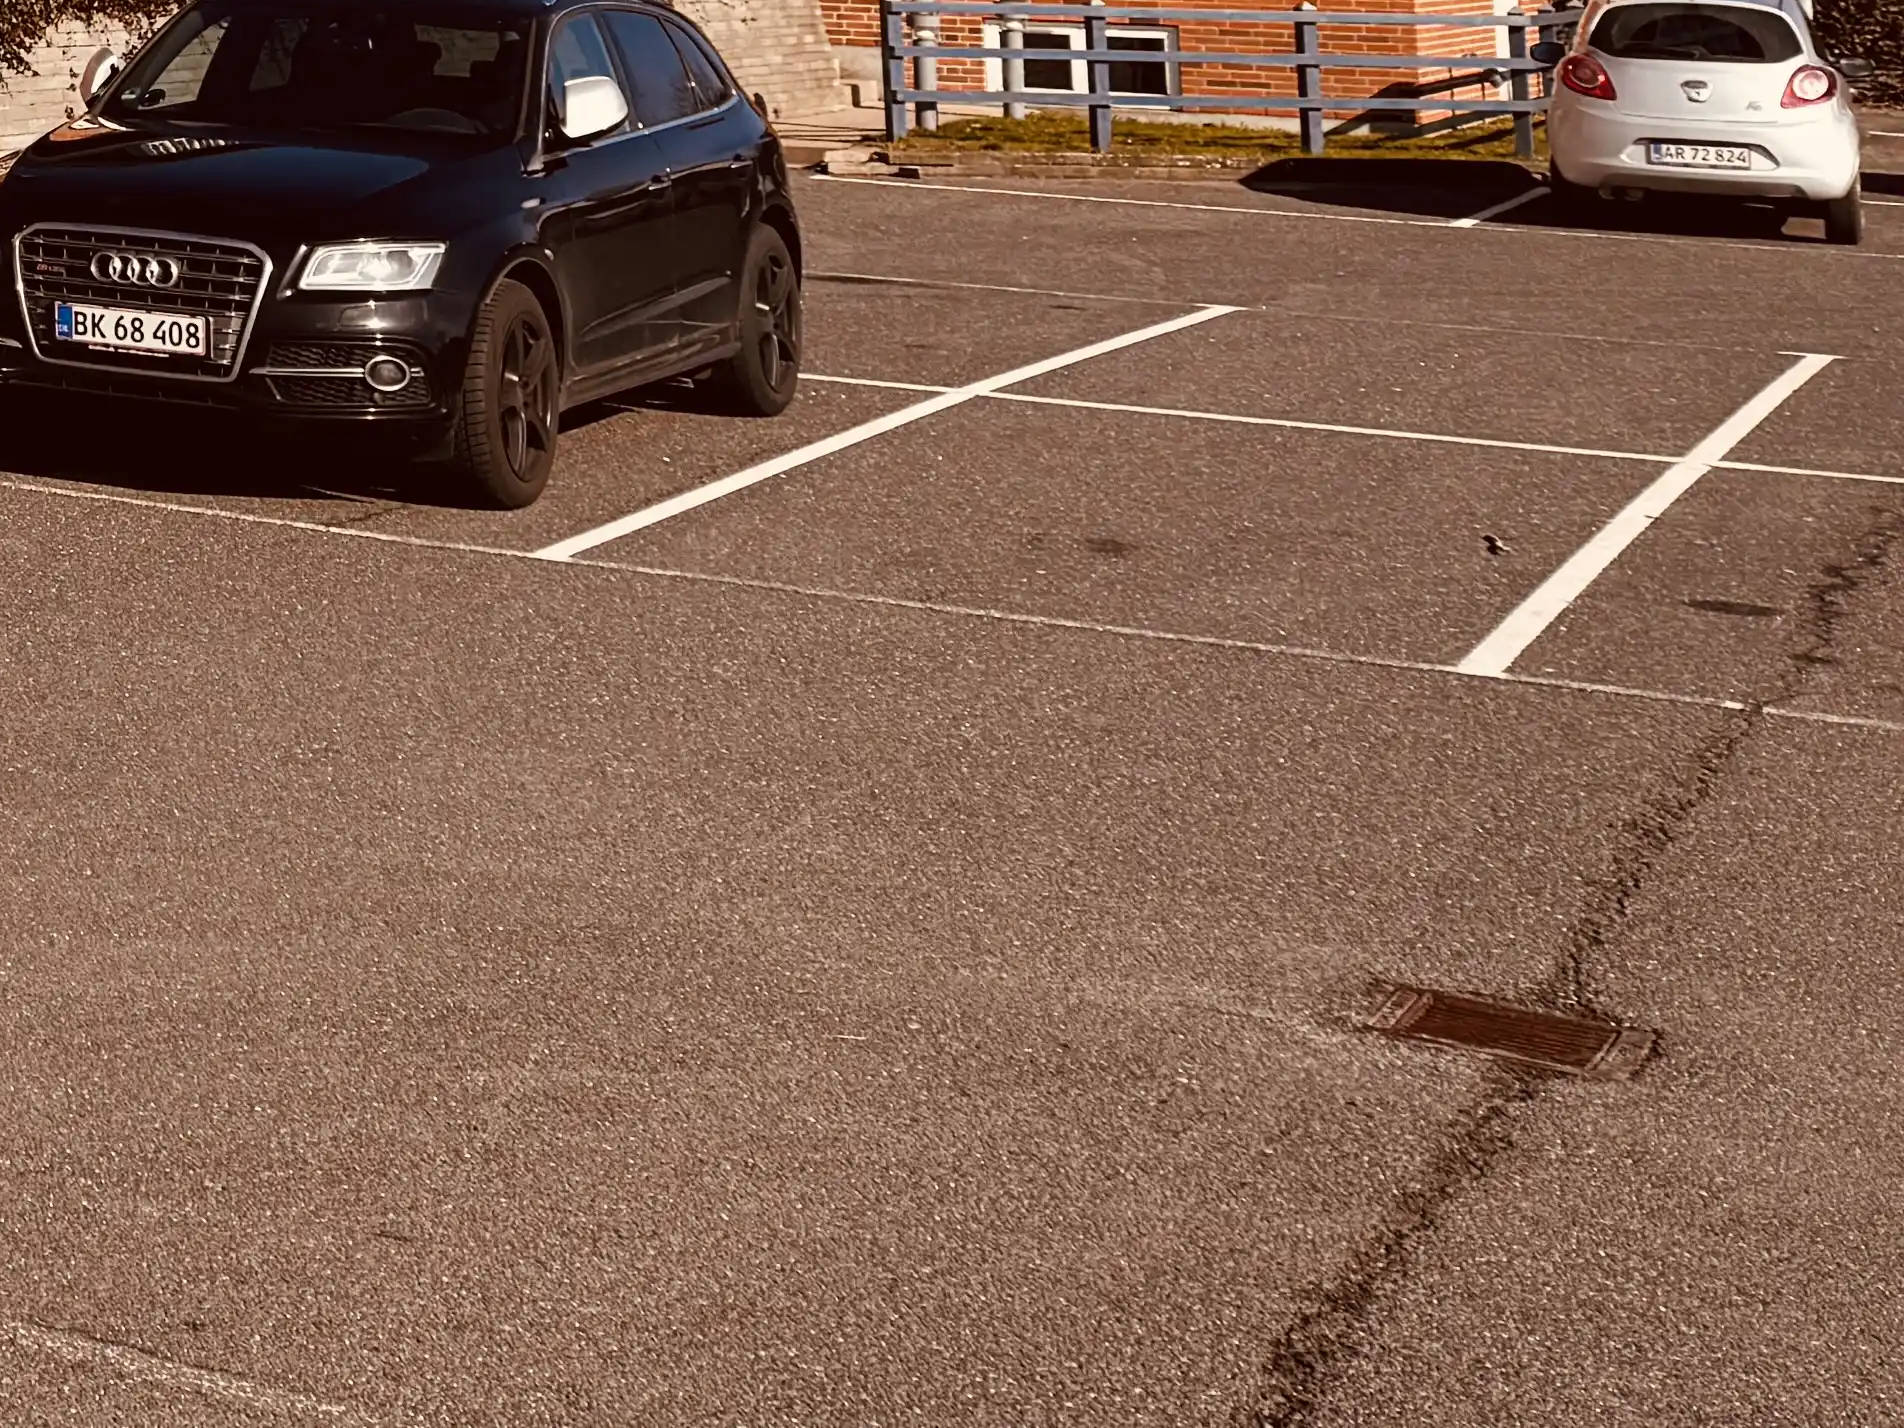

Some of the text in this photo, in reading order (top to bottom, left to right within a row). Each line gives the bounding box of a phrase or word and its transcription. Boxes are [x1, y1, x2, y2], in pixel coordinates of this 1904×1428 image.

[1664, 146, 1746, 164] AR 72 824
[74, 310, 200, 349] BK 68 408
